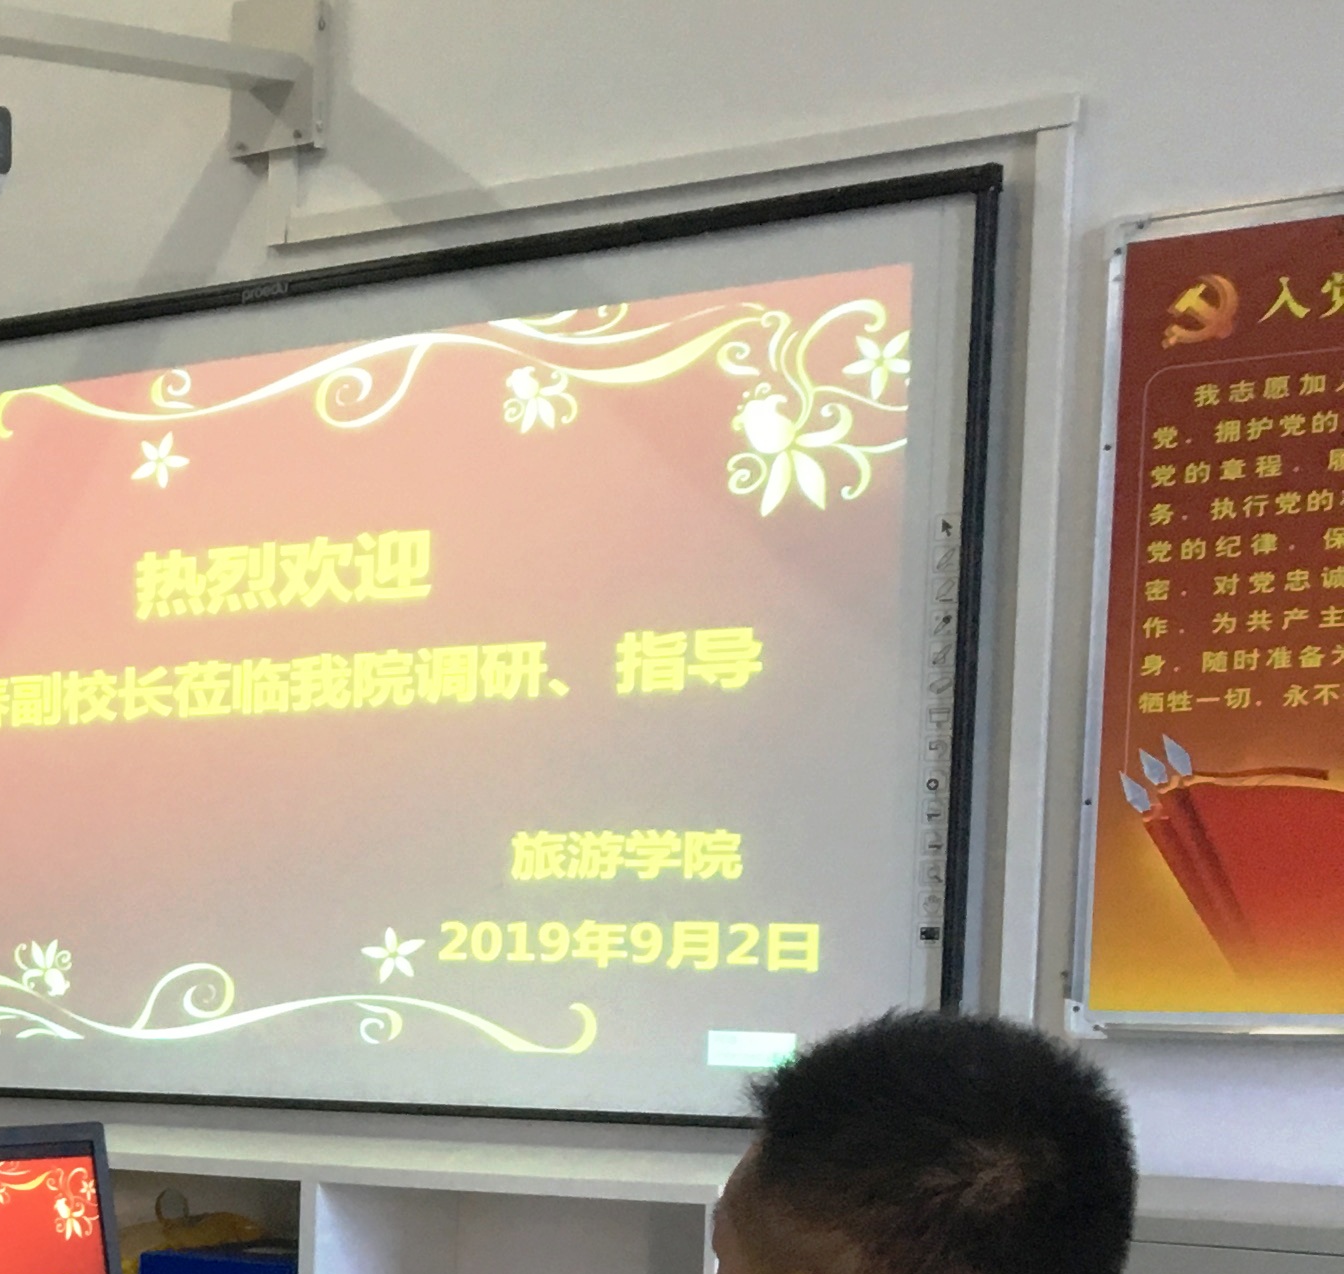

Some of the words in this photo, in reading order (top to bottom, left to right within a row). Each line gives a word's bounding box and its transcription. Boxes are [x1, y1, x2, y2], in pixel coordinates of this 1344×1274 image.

[1193, 372, 1344, 408] 我志愿加
[134, 529, 434, 621] 热烈欢迎
[510, 829, 743, 882] 旅游学院
[437, 919, 822, 973] 2019年9月2日
